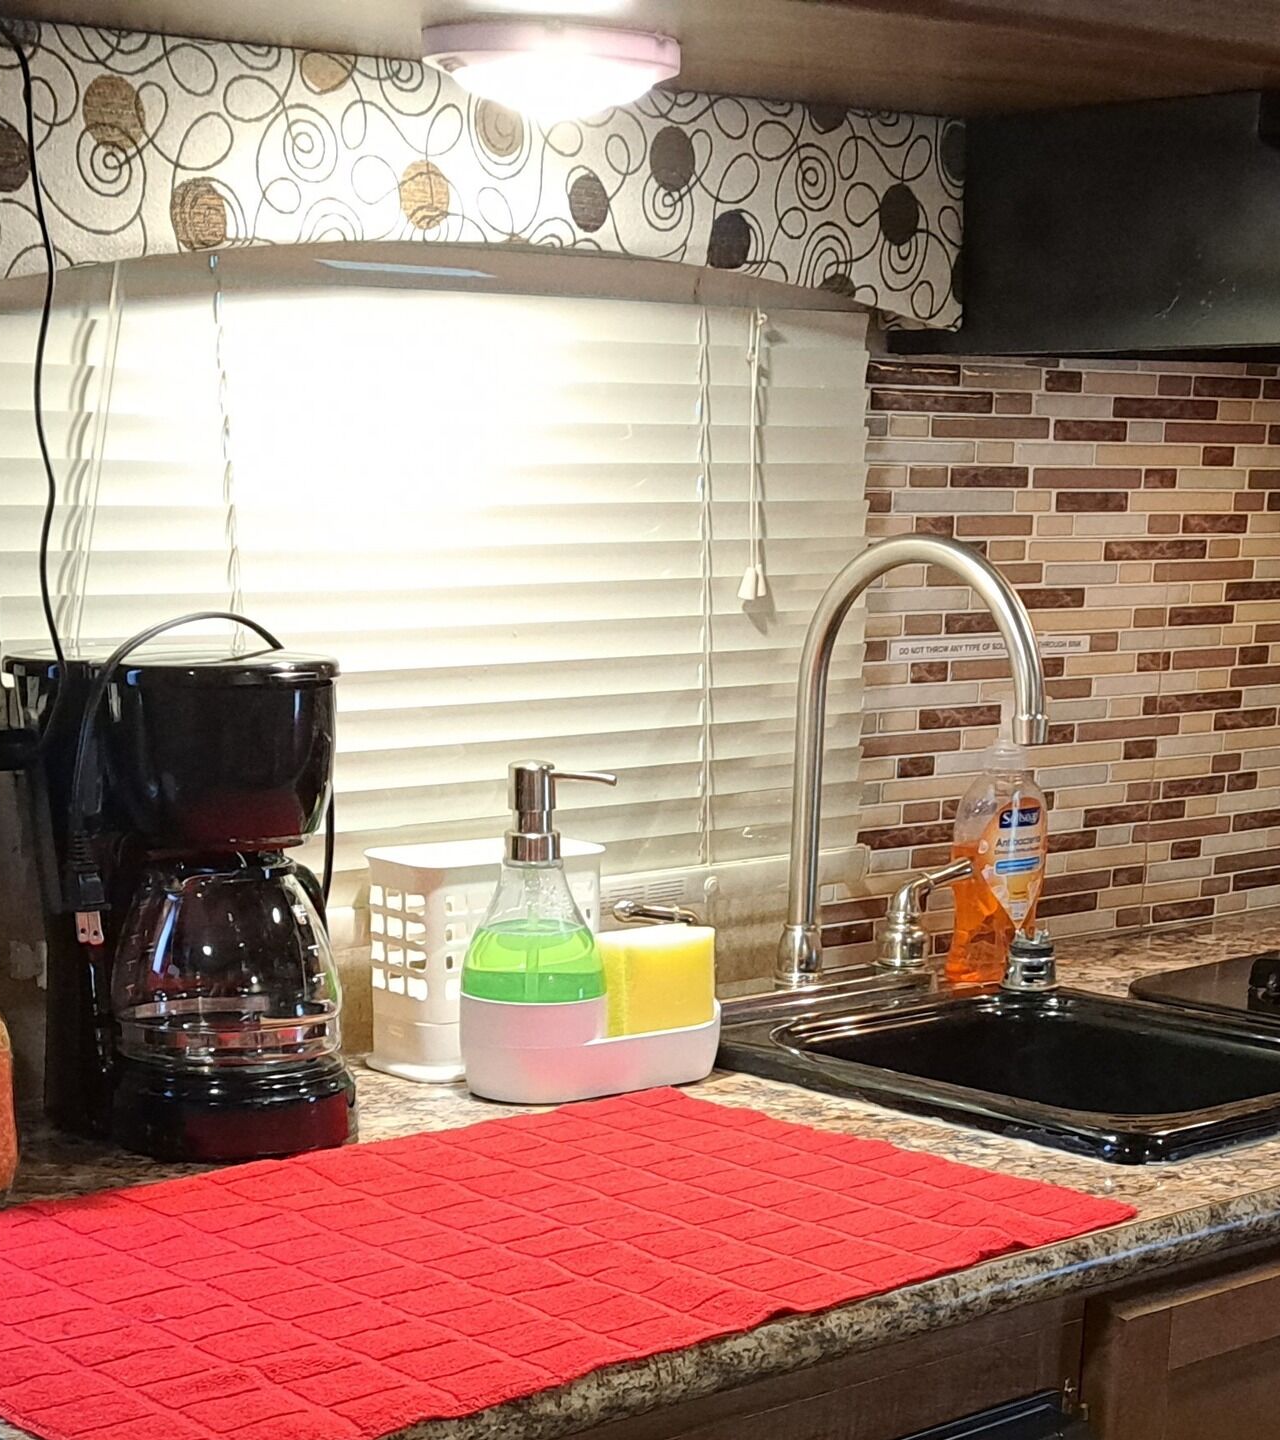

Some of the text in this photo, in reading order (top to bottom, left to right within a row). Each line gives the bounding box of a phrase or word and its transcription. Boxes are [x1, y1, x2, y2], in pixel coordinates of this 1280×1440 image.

[926, 646, 948, 654] THROW
[965, 644, 980, 652] TYPE
[992, 642, 1007, 650] SOL
[1001, 811, 1039, 825] Ssoap
